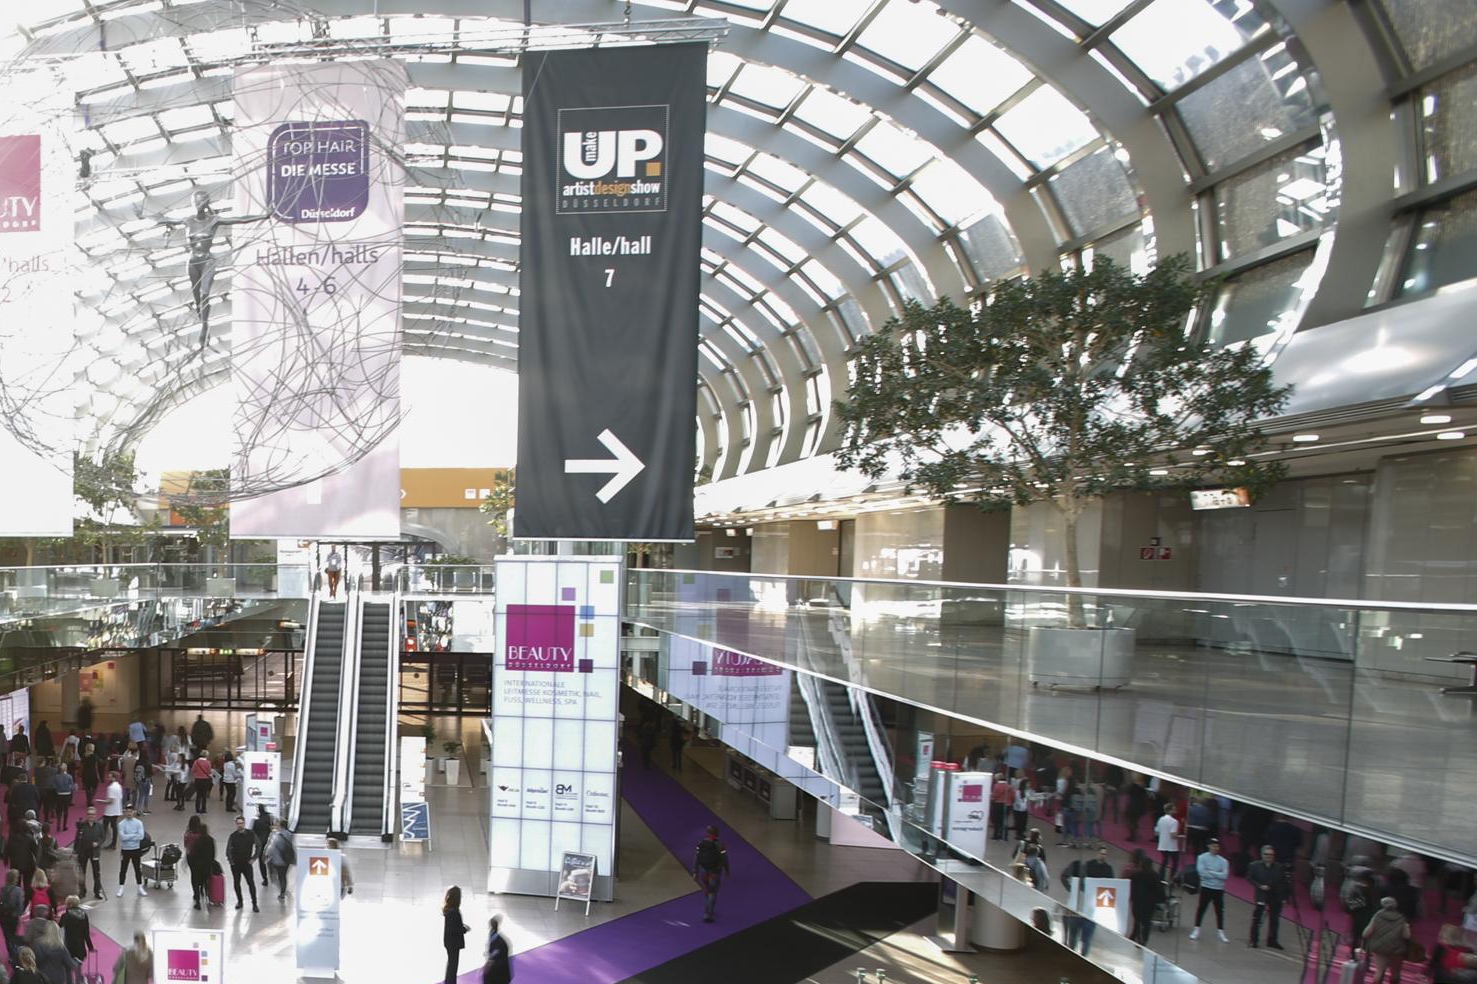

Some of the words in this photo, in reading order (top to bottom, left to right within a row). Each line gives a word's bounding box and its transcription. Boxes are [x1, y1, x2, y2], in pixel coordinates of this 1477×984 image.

[582, 131, 598, 162] make
[281, 165, 306, 177] DIE
[308, 163, 356, 176] MESSE
[563, 180, 661, 197] artistdesignshow
[570, 236, 651, 256] Halle/hall
[256, 244, 379, 267] Hallen/halls
[604, 268, 615, 288] 7
[508, 646, 572, 662] BEAUTY
[168, 968, 198, 977] BEAUTY
